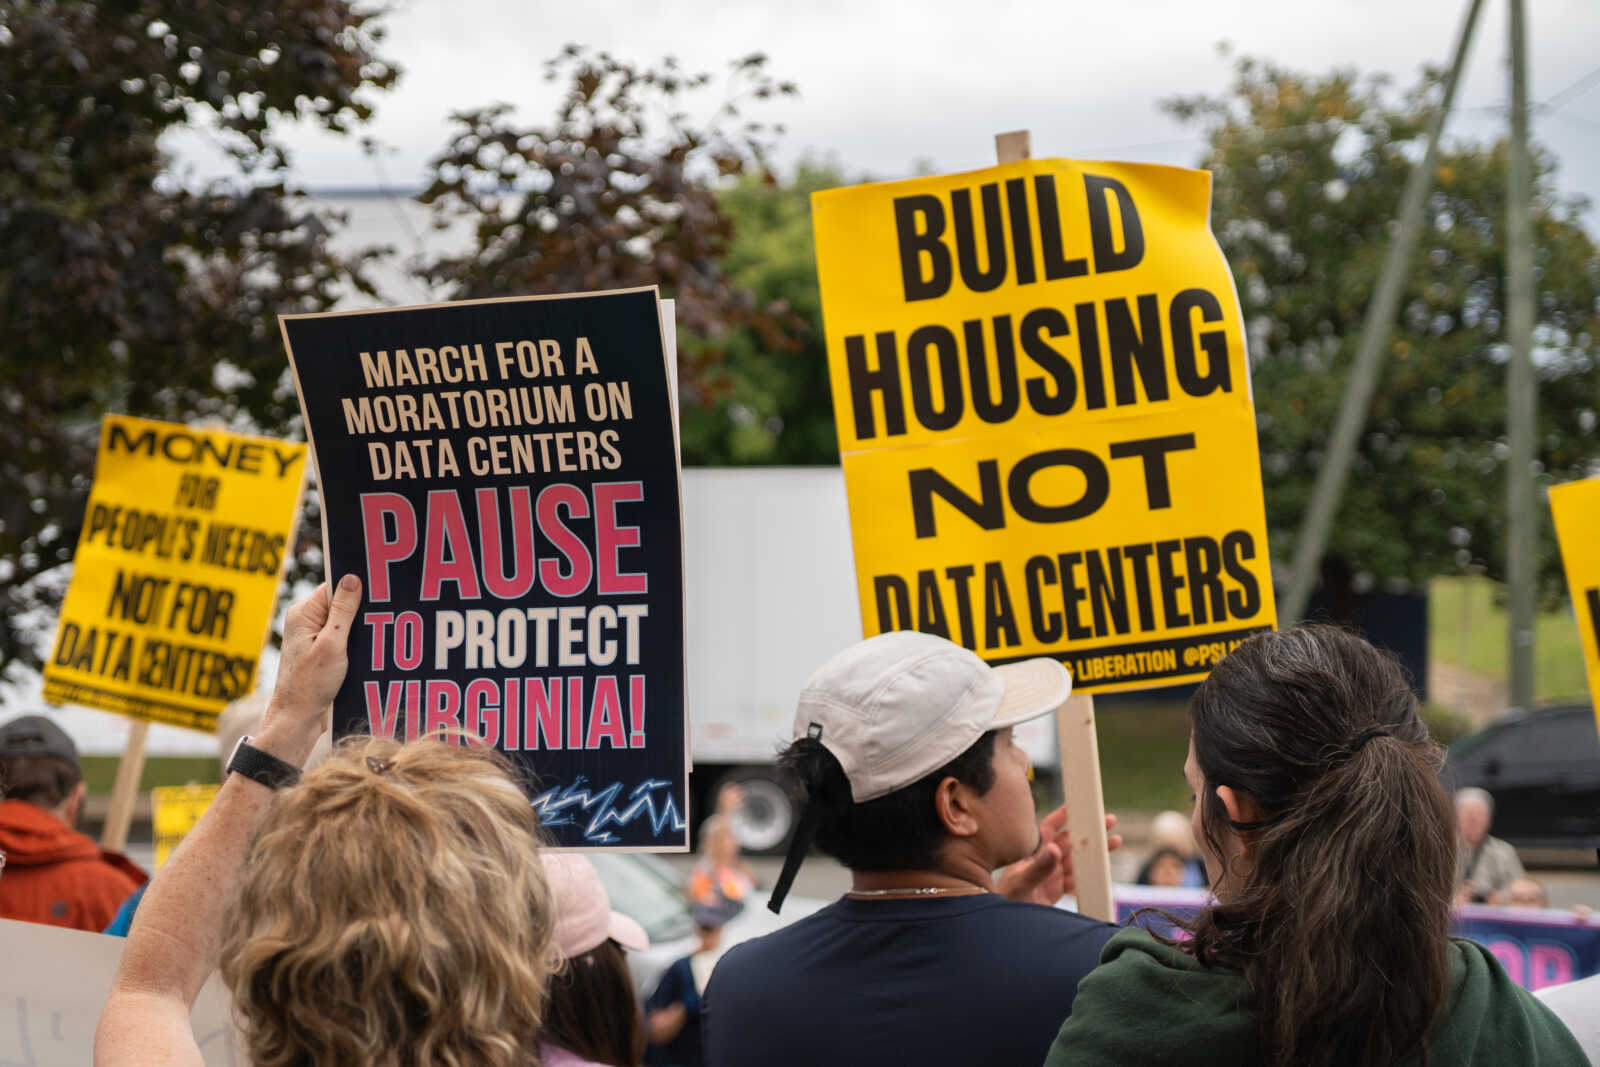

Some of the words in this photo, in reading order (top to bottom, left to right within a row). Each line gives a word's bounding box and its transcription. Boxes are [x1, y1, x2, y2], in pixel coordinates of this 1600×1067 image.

[893, 173, 1146, 303] BUILD
[359, 343, 489, 389] MARCH
[495, 339, 567, 381] FOR
[575, 336, 600, 376] A
[844, 287, 1234, 441] HOUSING
[341, 384, 577, 435] MORATORIUM
[584, 381, 634, 422] ON
[106, 422, 301, 478] MONEY
[367, 438, 461, 481] DATA
[467, 429, 623, 477] CENTERS
[907, 431, 1197, 540] NOT
[201, 523, 285, 577] NEEDS
[359, 480, 649, 603] PAUSE
[107, 568, 171, 629] NOT
[167, 579, 235, 641] FOR
[873, 560, 1022, 652] DATA
[1024, 529, 1262, 645] CENTERS
[55, 622, 134, 682] DATA
[363, 610, 425, 672] TO
[434, 603, 650, 671] PROTECT
[1076, 648, 1177, 682] LIBERATION
[363, 673, 647, 752] VIRGINIA!
